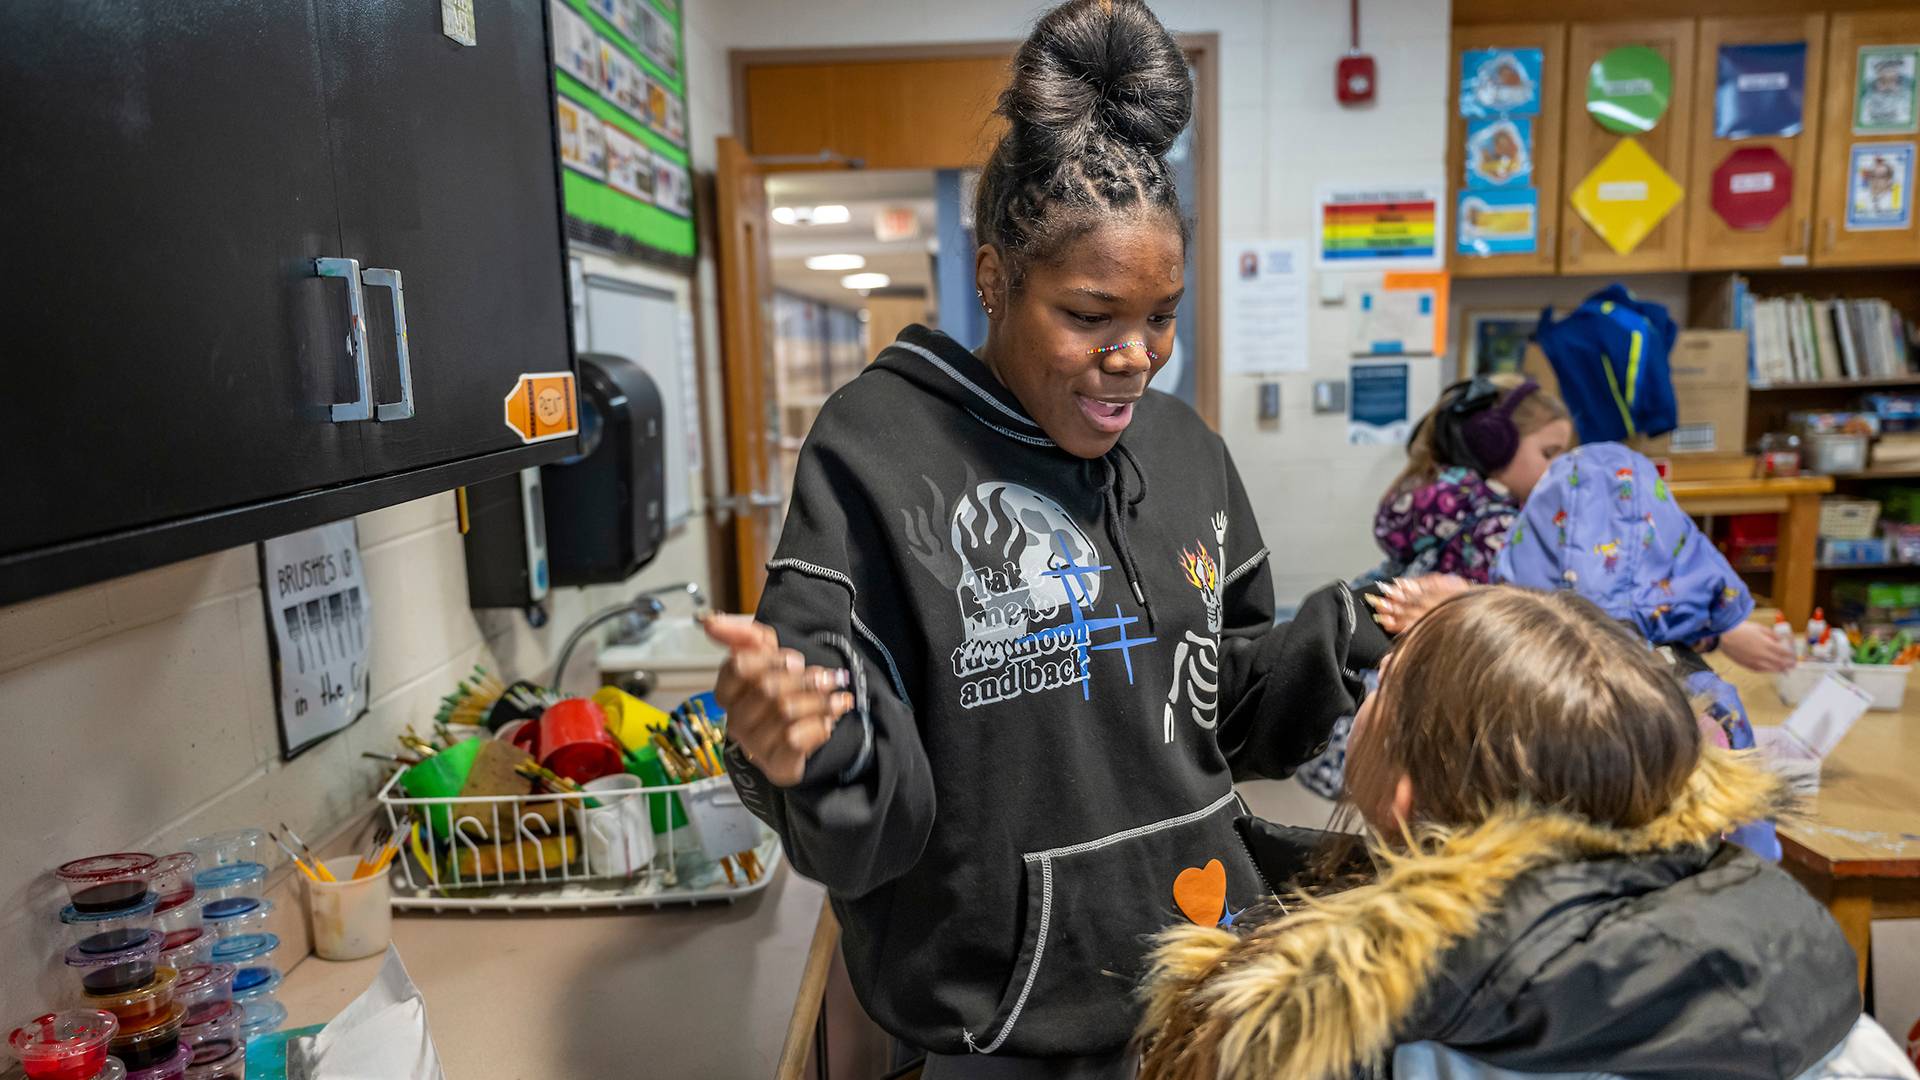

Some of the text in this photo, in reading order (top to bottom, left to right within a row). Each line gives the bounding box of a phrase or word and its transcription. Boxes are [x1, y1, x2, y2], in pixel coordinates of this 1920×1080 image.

[277, 554, 336, 598] BRUSHES
[963, 561, 1046, 604] Tak
[1006, 624, 1092, 662] moon
[295, 688, 309, 717] in
[321, 671, 344, 706] the
[960, 646, 1092, 709] and back
